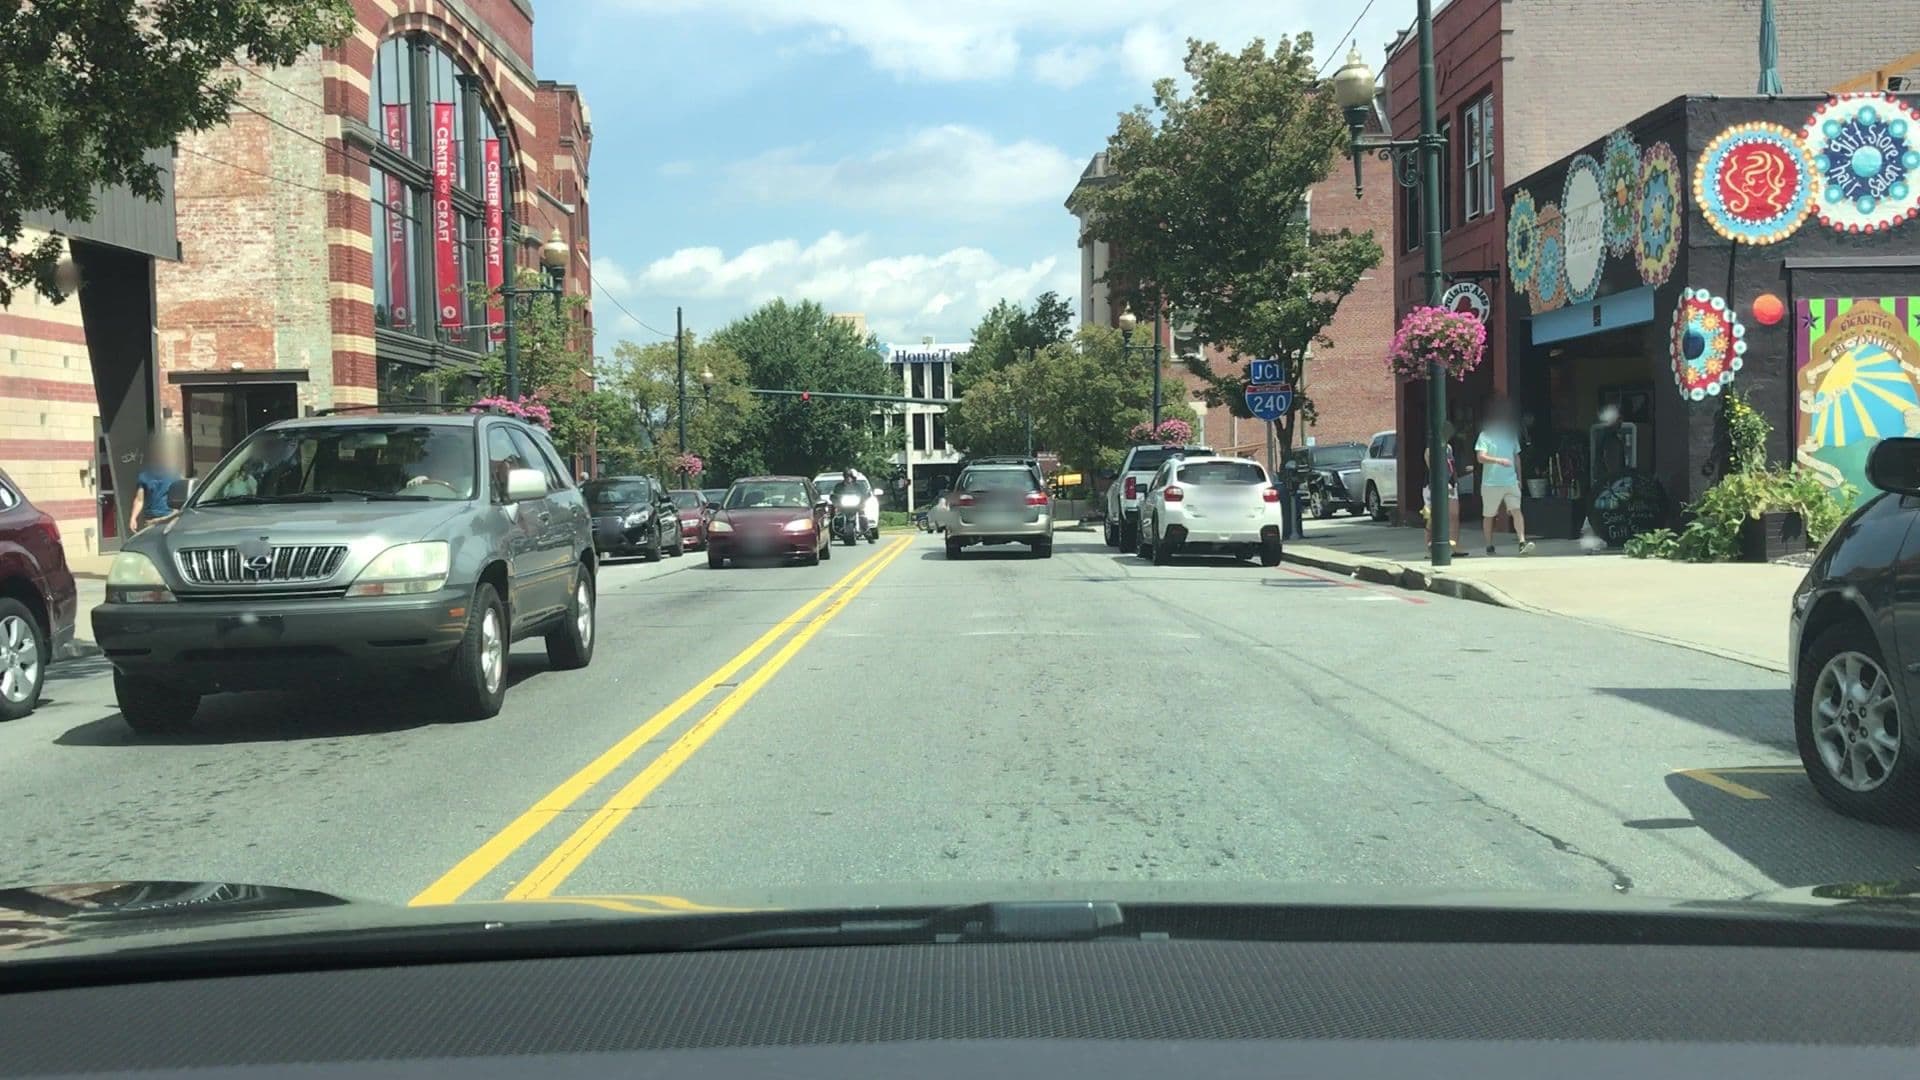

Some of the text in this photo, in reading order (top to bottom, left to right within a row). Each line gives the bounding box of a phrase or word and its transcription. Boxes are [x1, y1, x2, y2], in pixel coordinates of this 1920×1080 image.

[436, 127, 449, 177] CENTER
[1831, 122, 1866, 157] gift
[487, 162, 499, 207] CENTER
[1830, 160, 1862, 196] hair
[437, 200, 450, 242] CRAFT
[488, 227, 500, 267] CRAFT
[1445, 284, 1489, 309] ruisin' Ales
[1254, 363, 1280, 380] JCT
[1254, 394, 1286, 413] 240
